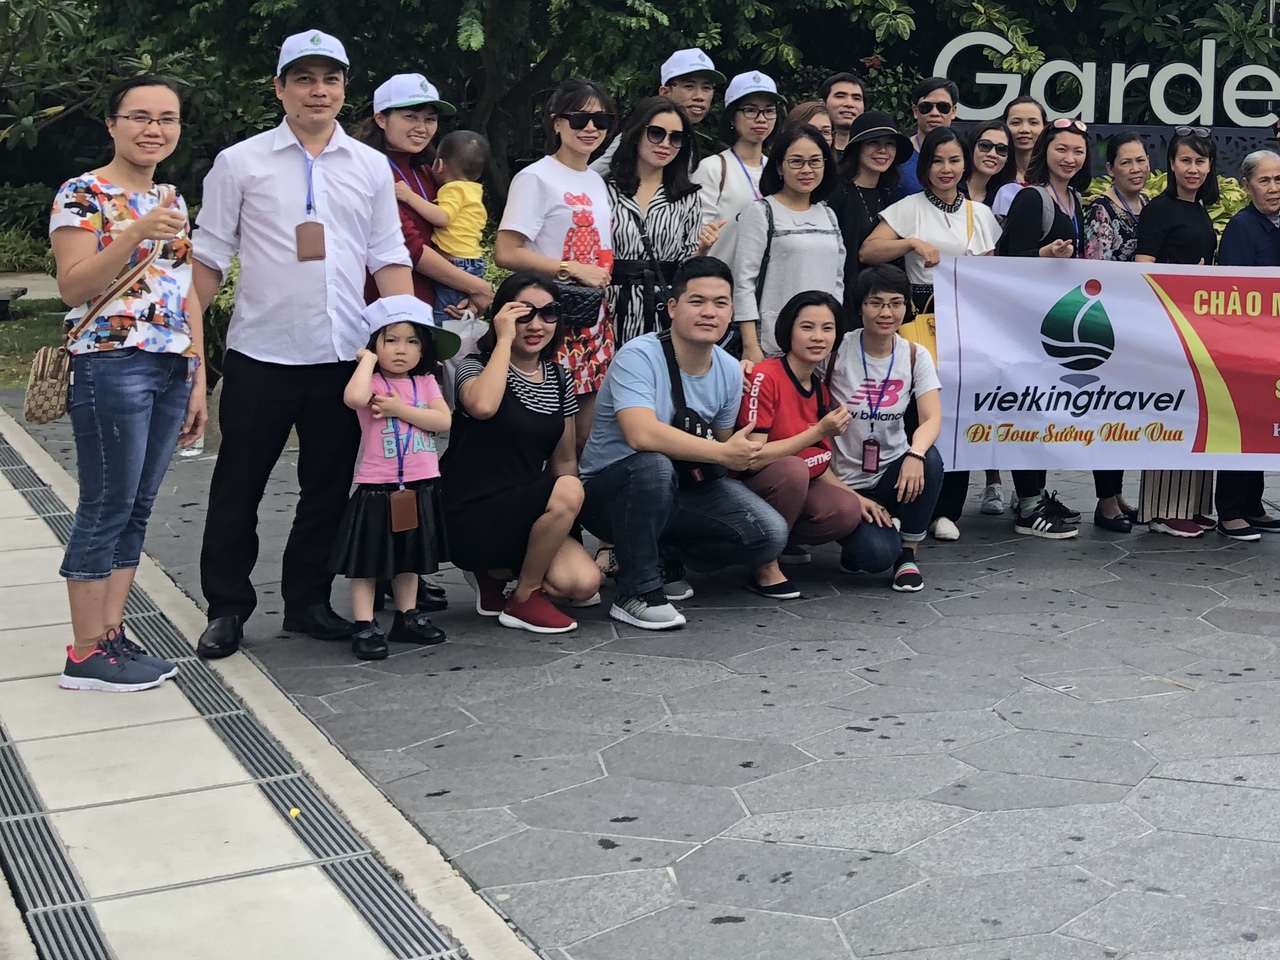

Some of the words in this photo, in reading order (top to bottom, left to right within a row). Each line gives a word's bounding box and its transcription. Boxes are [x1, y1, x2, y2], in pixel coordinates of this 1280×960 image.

[1193, 286, 1262, 317] CHÀO
[973, 384, 1186, 418] vietkingtravel
[965, 422, 991, 443] Đi
[995, 422, 1039, 443] Tour
[1144, 422, 1185, 443] Vua
